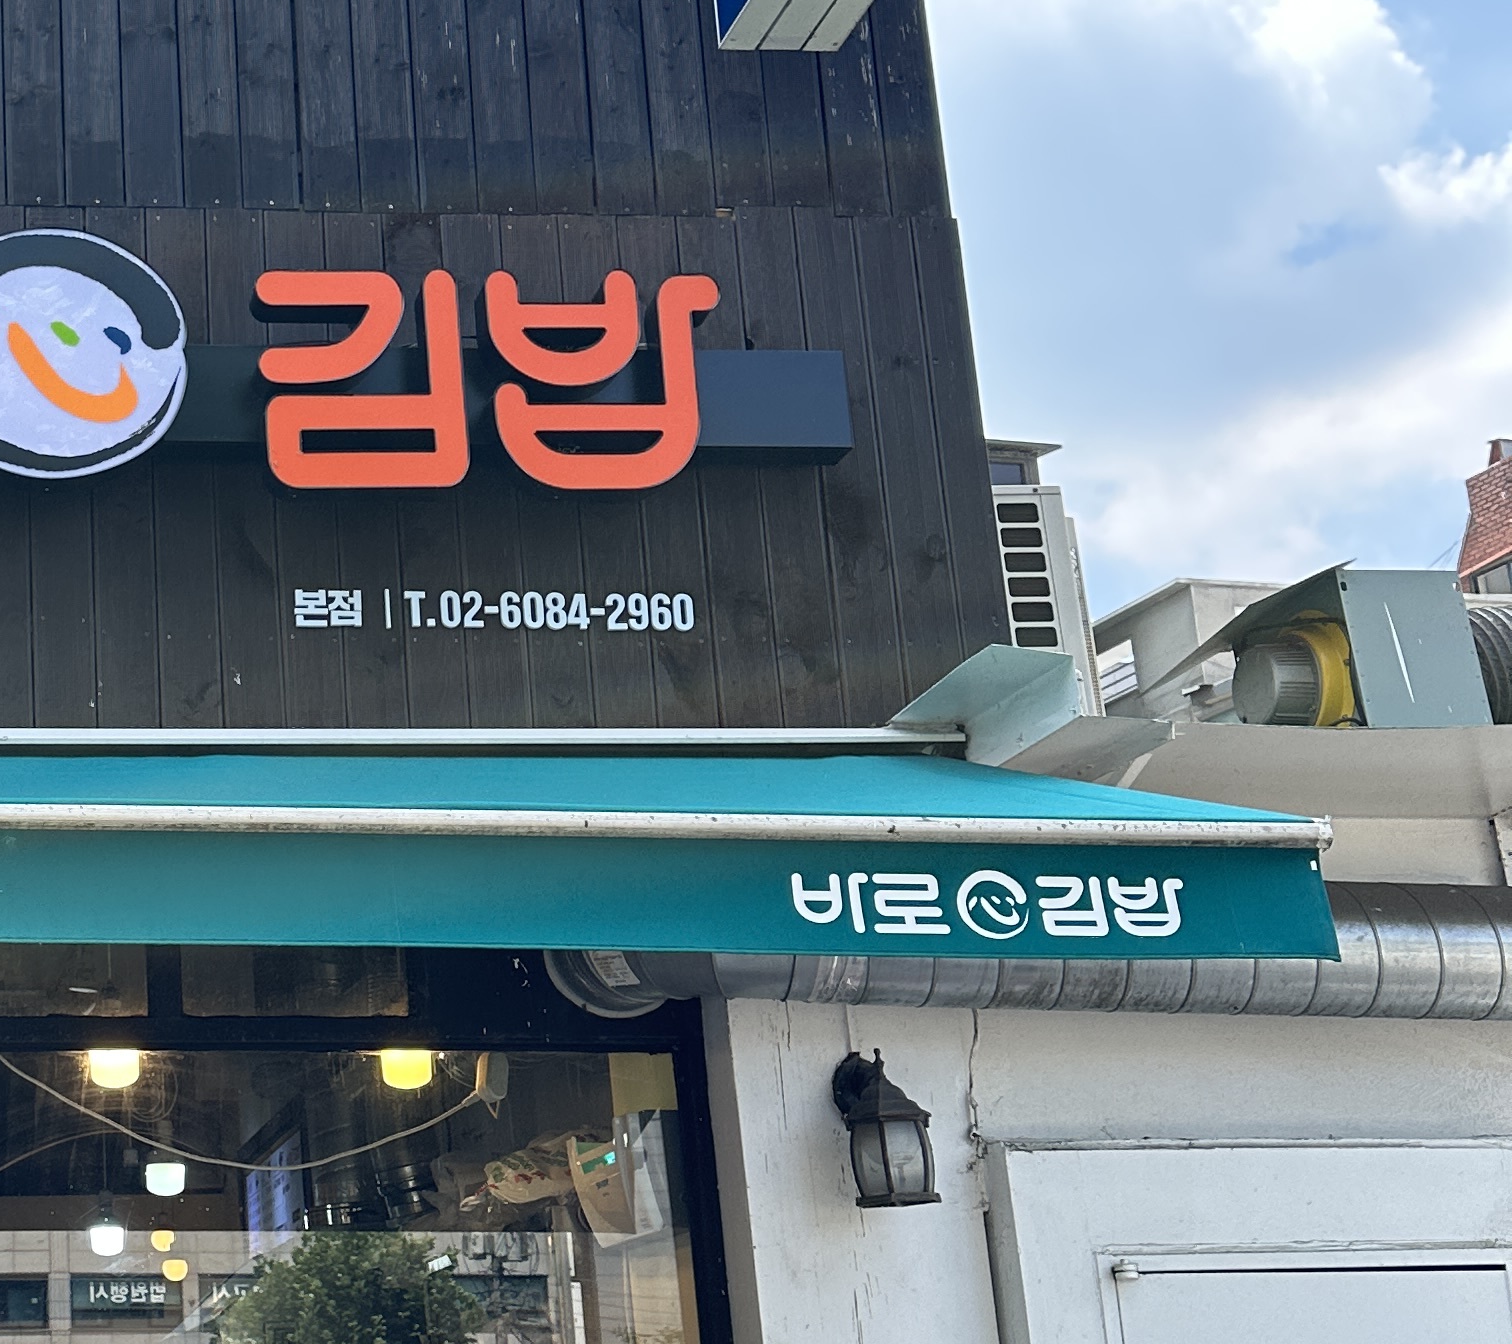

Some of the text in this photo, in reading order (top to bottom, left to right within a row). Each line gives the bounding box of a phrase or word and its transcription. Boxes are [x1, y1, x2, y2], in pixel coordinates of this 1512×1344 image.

[255, 268, 721, 491] 김밥
[293, 587, 363, 628] 본점
[791, 872, 1184, 937] 바로 김밥
